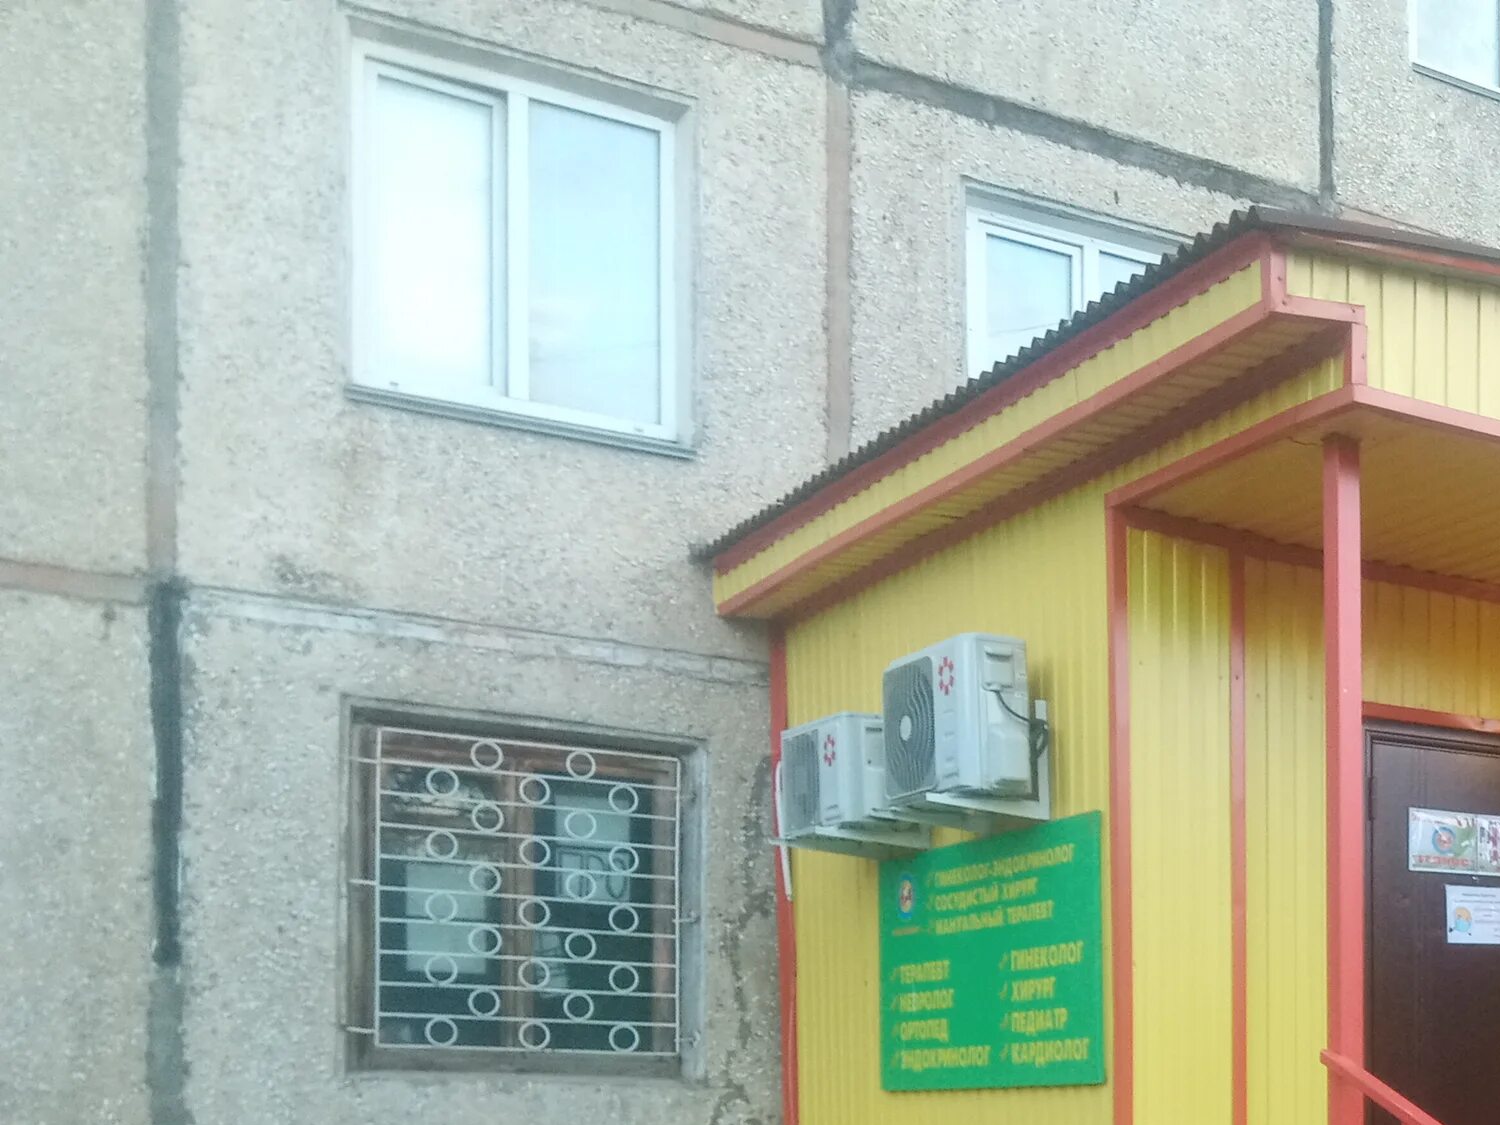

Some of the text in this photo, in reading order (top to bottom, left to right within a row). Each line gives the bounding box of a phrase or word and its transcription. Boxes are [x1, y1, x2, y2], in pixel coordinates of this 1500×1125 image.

[1011, 940, 1084, 972] ГИНЕКОЛОГ
[900, 960, 950, 984] ТЕРАПЕВТ
[900, 988, 954, 1013] НЕВРОЛОГ
[1011, 977, 1056, 1002] ХИРУРГ
[900, 1018, 949, 1042] ОРТОПЕД
[1011, 1007, 1068, 1035] ПЕДИАТР
[901, 1045, 991, 1072] ЭНДОКРИНОЛОГ
[1011, 1038, 1090, 1067] КАРДИОЛОГ
